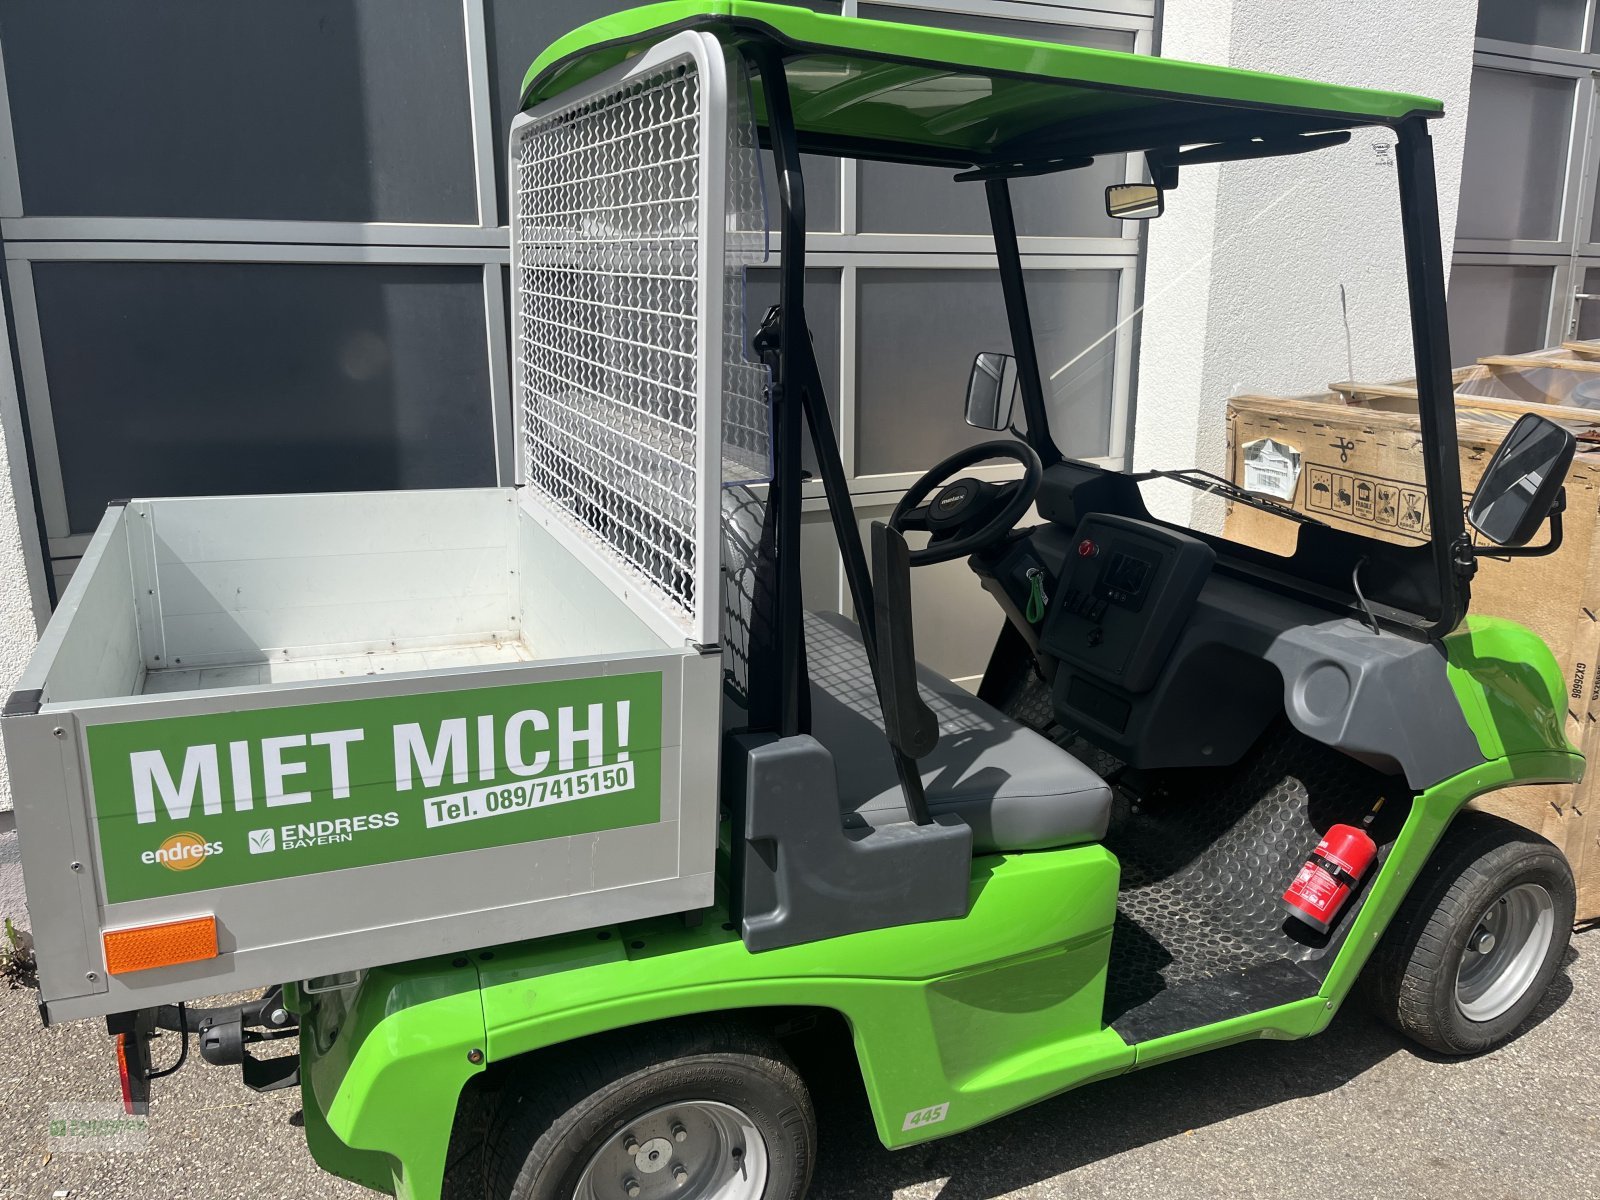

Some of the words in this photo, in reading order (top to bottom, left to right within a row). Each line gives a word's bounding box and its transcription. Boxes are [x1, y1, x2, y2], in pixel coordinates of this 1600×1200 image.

[1572, 663, 1586, 698] GX26686
[129, 728, 365, 824] MIET
[393, 699, 630, 792] MICH!
[431, 795, 478, 822] Tel.
[485, 767, 629, 812] 089/7415150
[281, 811, 399, 841] ENDRESS
[141, 841, 224, 864] endress
[282, 833, 353, 850] BAYERN
[910, 1106, 943, 1125] 445
